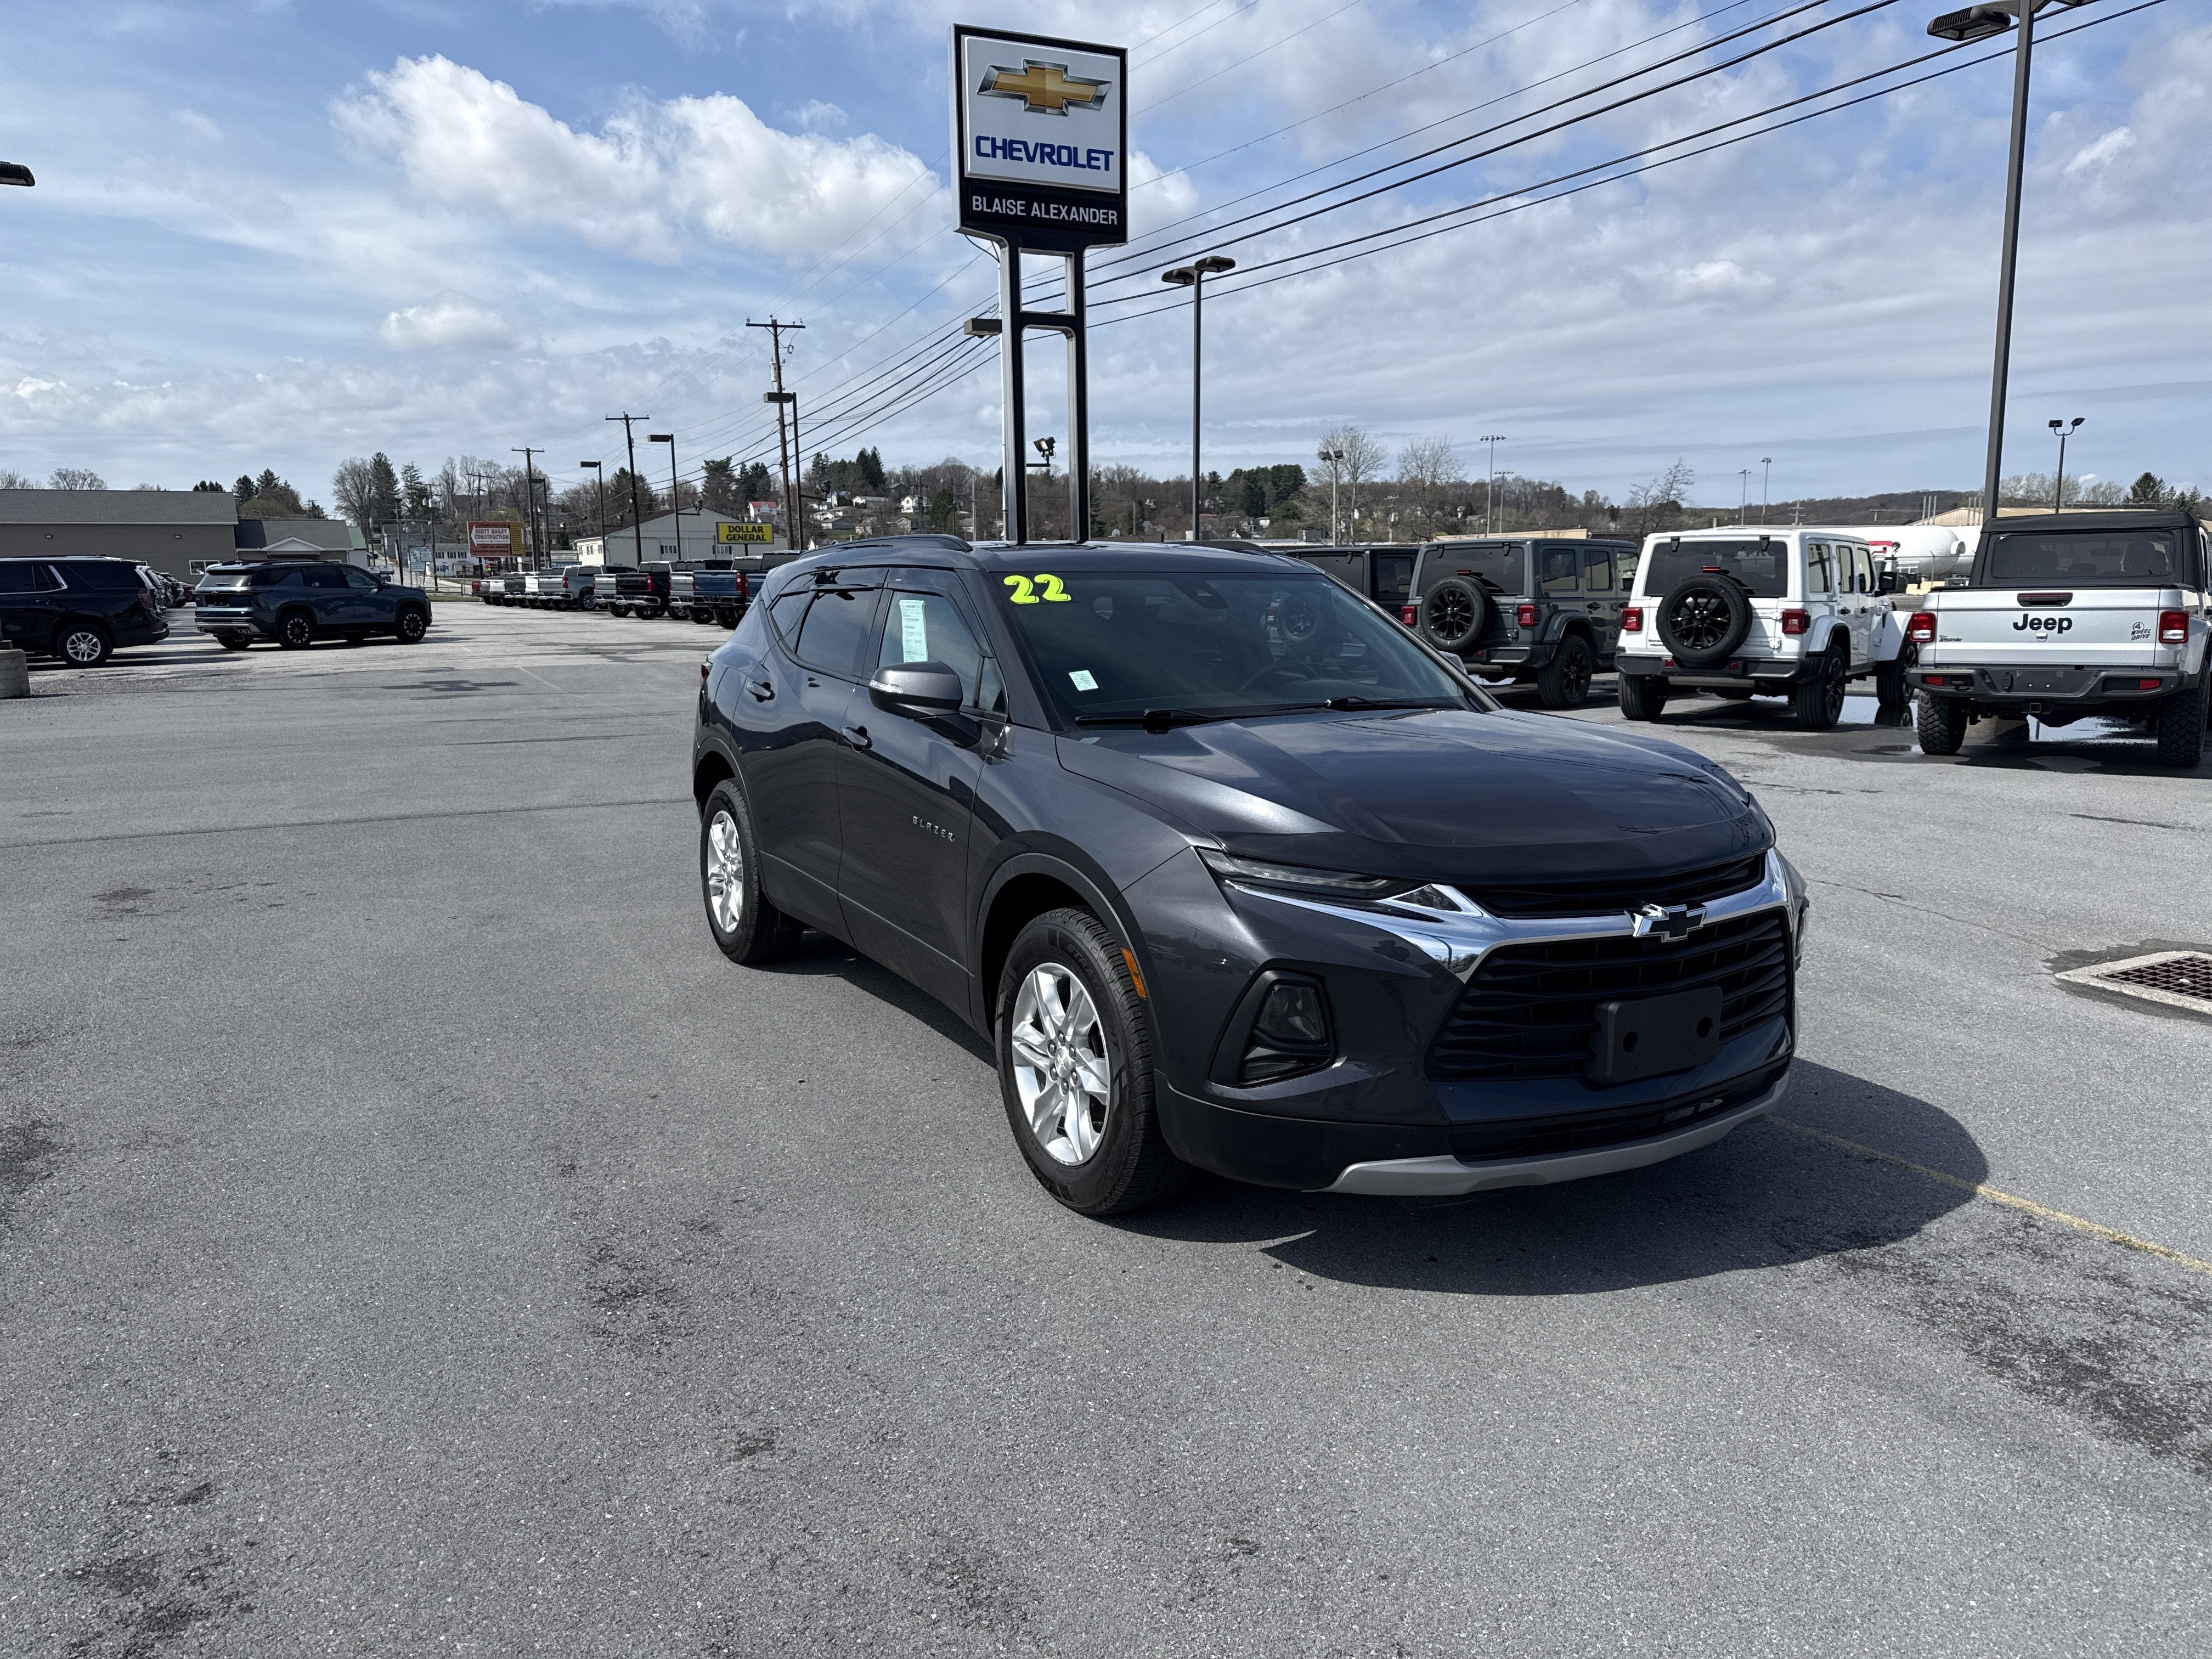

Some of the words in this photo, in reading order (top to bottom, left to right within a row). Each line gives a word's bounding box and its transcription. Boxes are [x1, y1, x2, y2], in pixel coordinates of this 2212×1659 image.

[975, 135, 1114, 171] CHEVROLET
[972, 195, 1026, 216] BLAISE
[1031, 202, 1118, 225] ALEXANDER
[726, 533, 767, 541] GENERAL
[727, 525, 764, 533] DOLLAR
[1003, 574, 1071, 604] 22
[2012, 613, 2073, 634] Jeep
[913, 816, 955, 842] BLAZER
